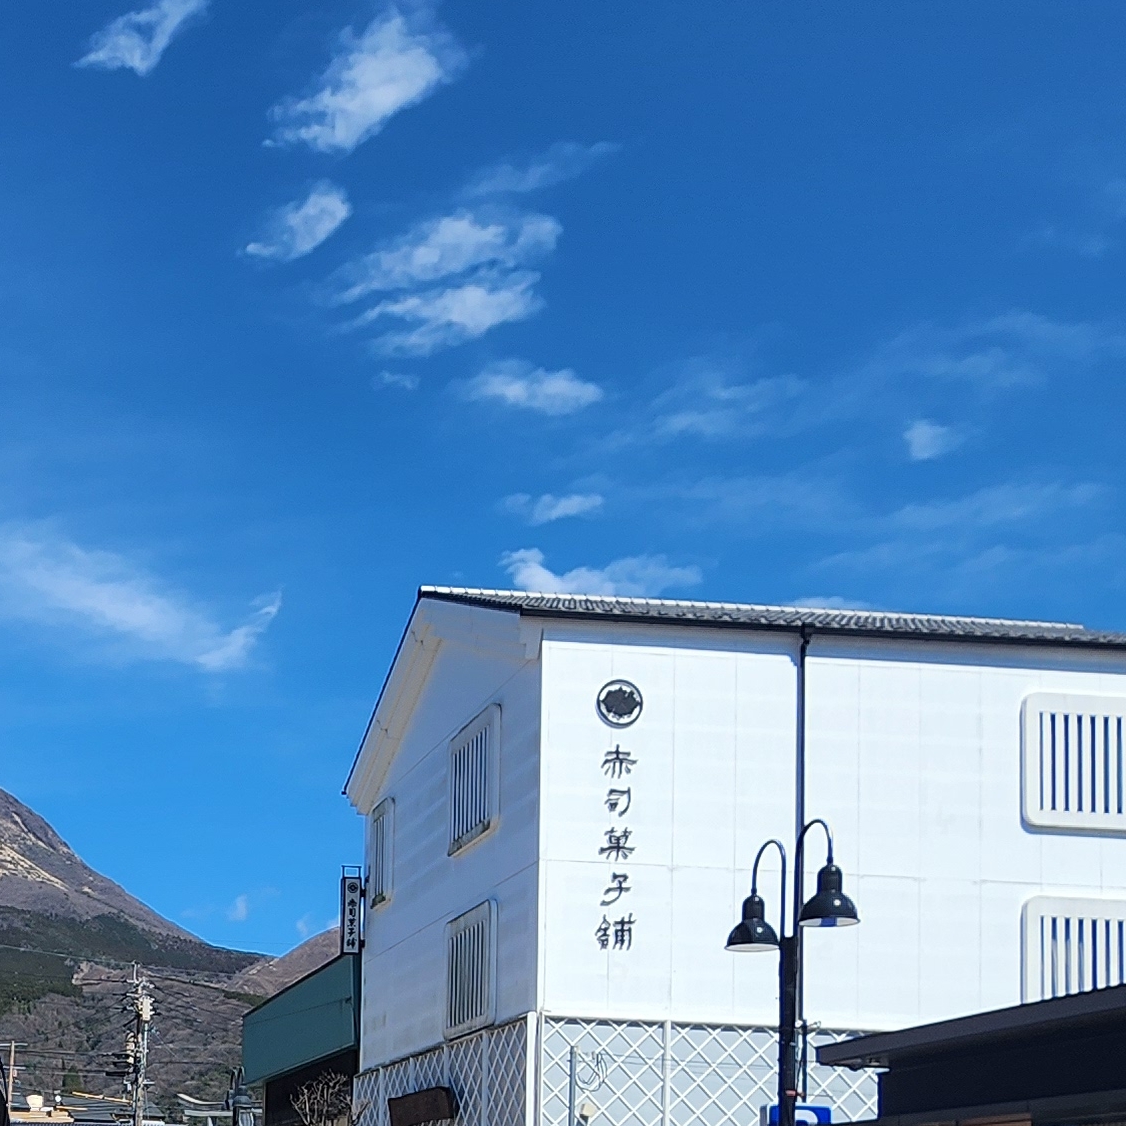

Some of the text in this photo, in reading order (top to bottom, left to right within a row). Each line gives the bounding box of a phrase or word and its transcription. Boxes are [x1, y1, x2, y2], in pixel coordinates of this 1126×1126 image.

[595, 744, 638, 951] 赤司菓子舗
